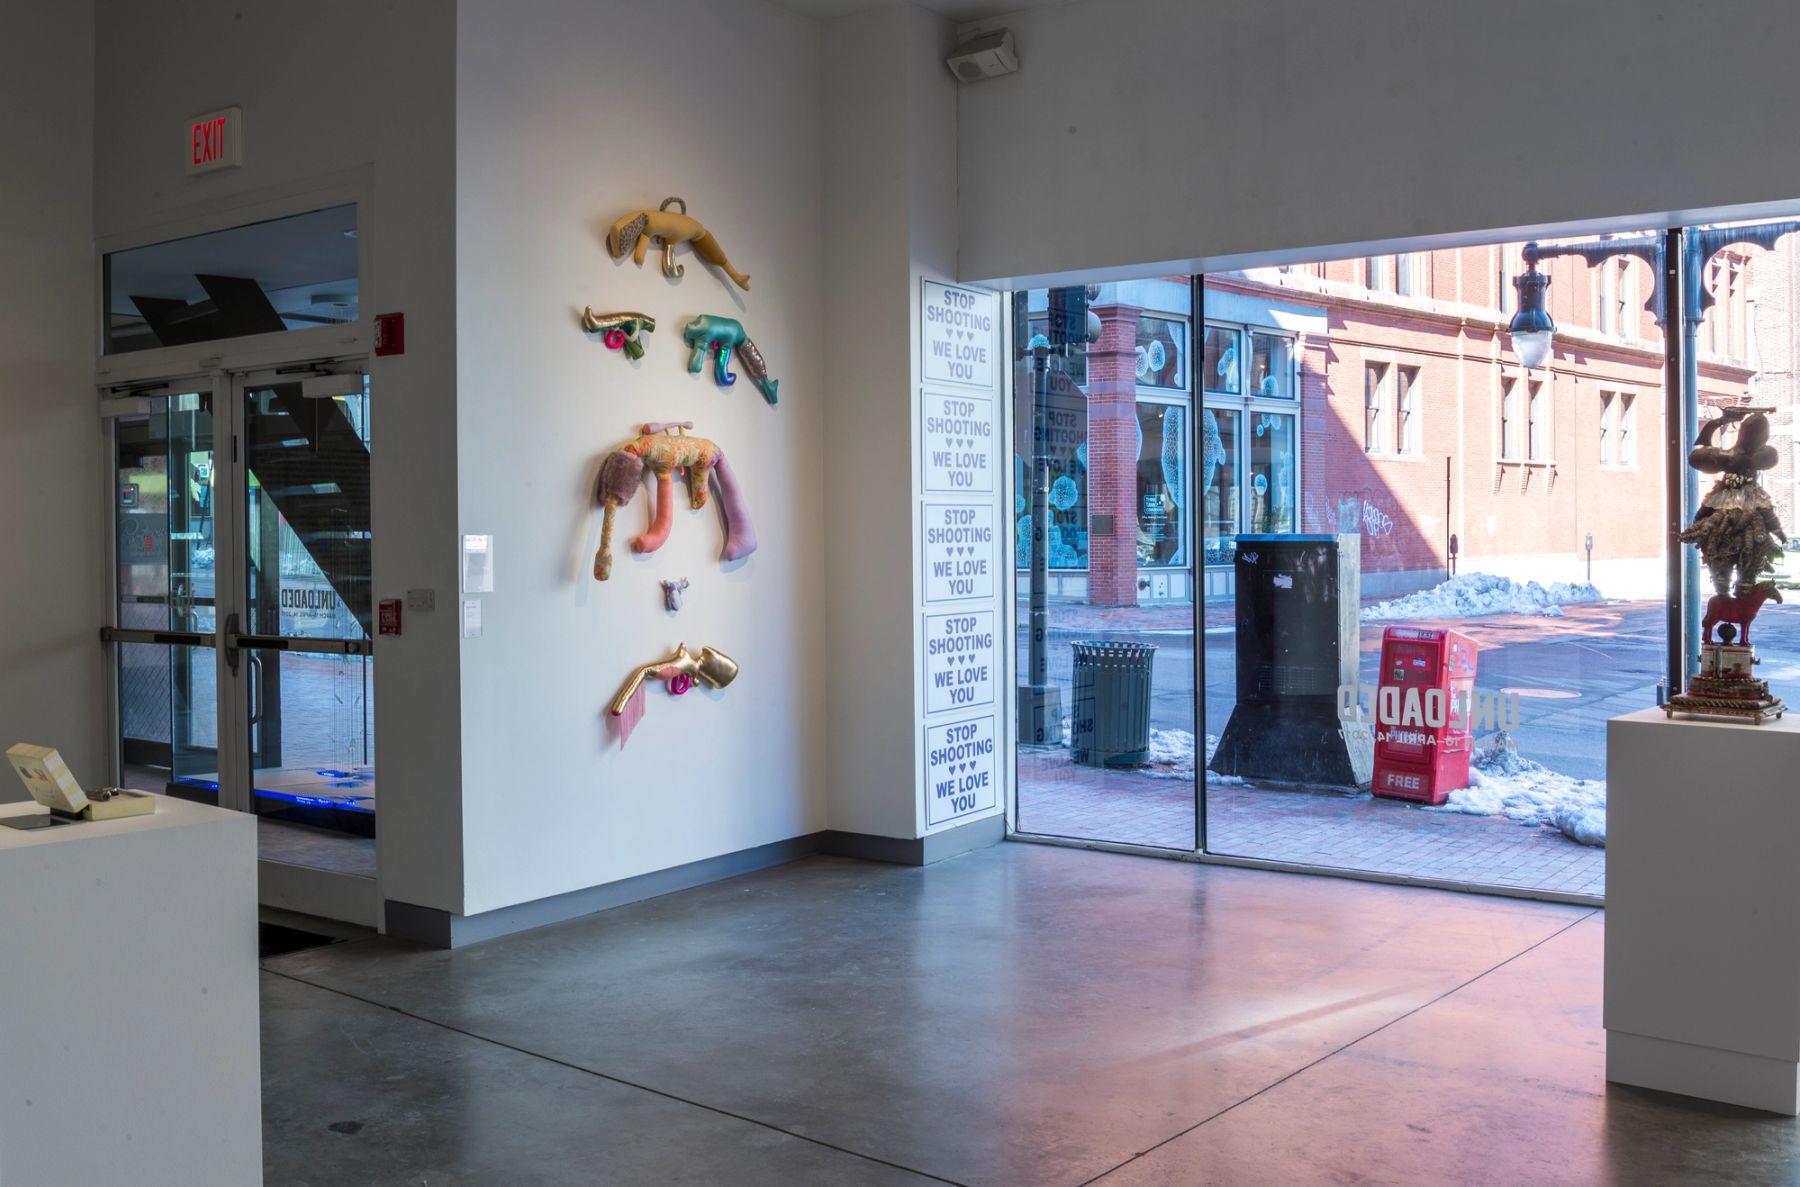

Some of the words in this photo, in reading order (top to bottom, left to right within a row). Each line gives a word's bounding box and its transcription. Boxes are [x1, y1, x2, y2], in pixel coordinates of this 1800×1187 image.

[192, 117, 224, 164] EXIT
[944, 290, 975, 309] STOP
[927, 306, 990, 332] SHOOTING
[933, 340, 952, 358] WE
[956, 342, 986, 363] LOVE
[948, 362, 972, 379] YOU
[944, 400, 974, 418] STOP
[927, 417, 990, 437] SHOOTING
[933, 452, 952, 467] WE
[956, 453, 986, 469] LOVE
[948, 471, 973, 486] YOU
[944, 510, 976, 525] STOP
[928, 528, 991, 544] SHOOTING
[934, 561, 952, 577] WE
[957, 560, 987, 576] LOVE
[948, 579, 973, 594] YOU
[946, 617, 977, 634] STOP
[929, 633, 992, 655] SHOOTING
[934, 670, 953, 688] WE
[958, 666, 987, 684] LOVE
[950, 686, 974, 704] YOU
[947, 724, 977, 744] STOP
[931, 738, 993, 766] SHOOTING
[936, 779, 955, 798] WE
[959, 771, 989, 793] LOVE
[1387, 774, 1420, 790] FREE
[951, 793, 976, 813] YOU
